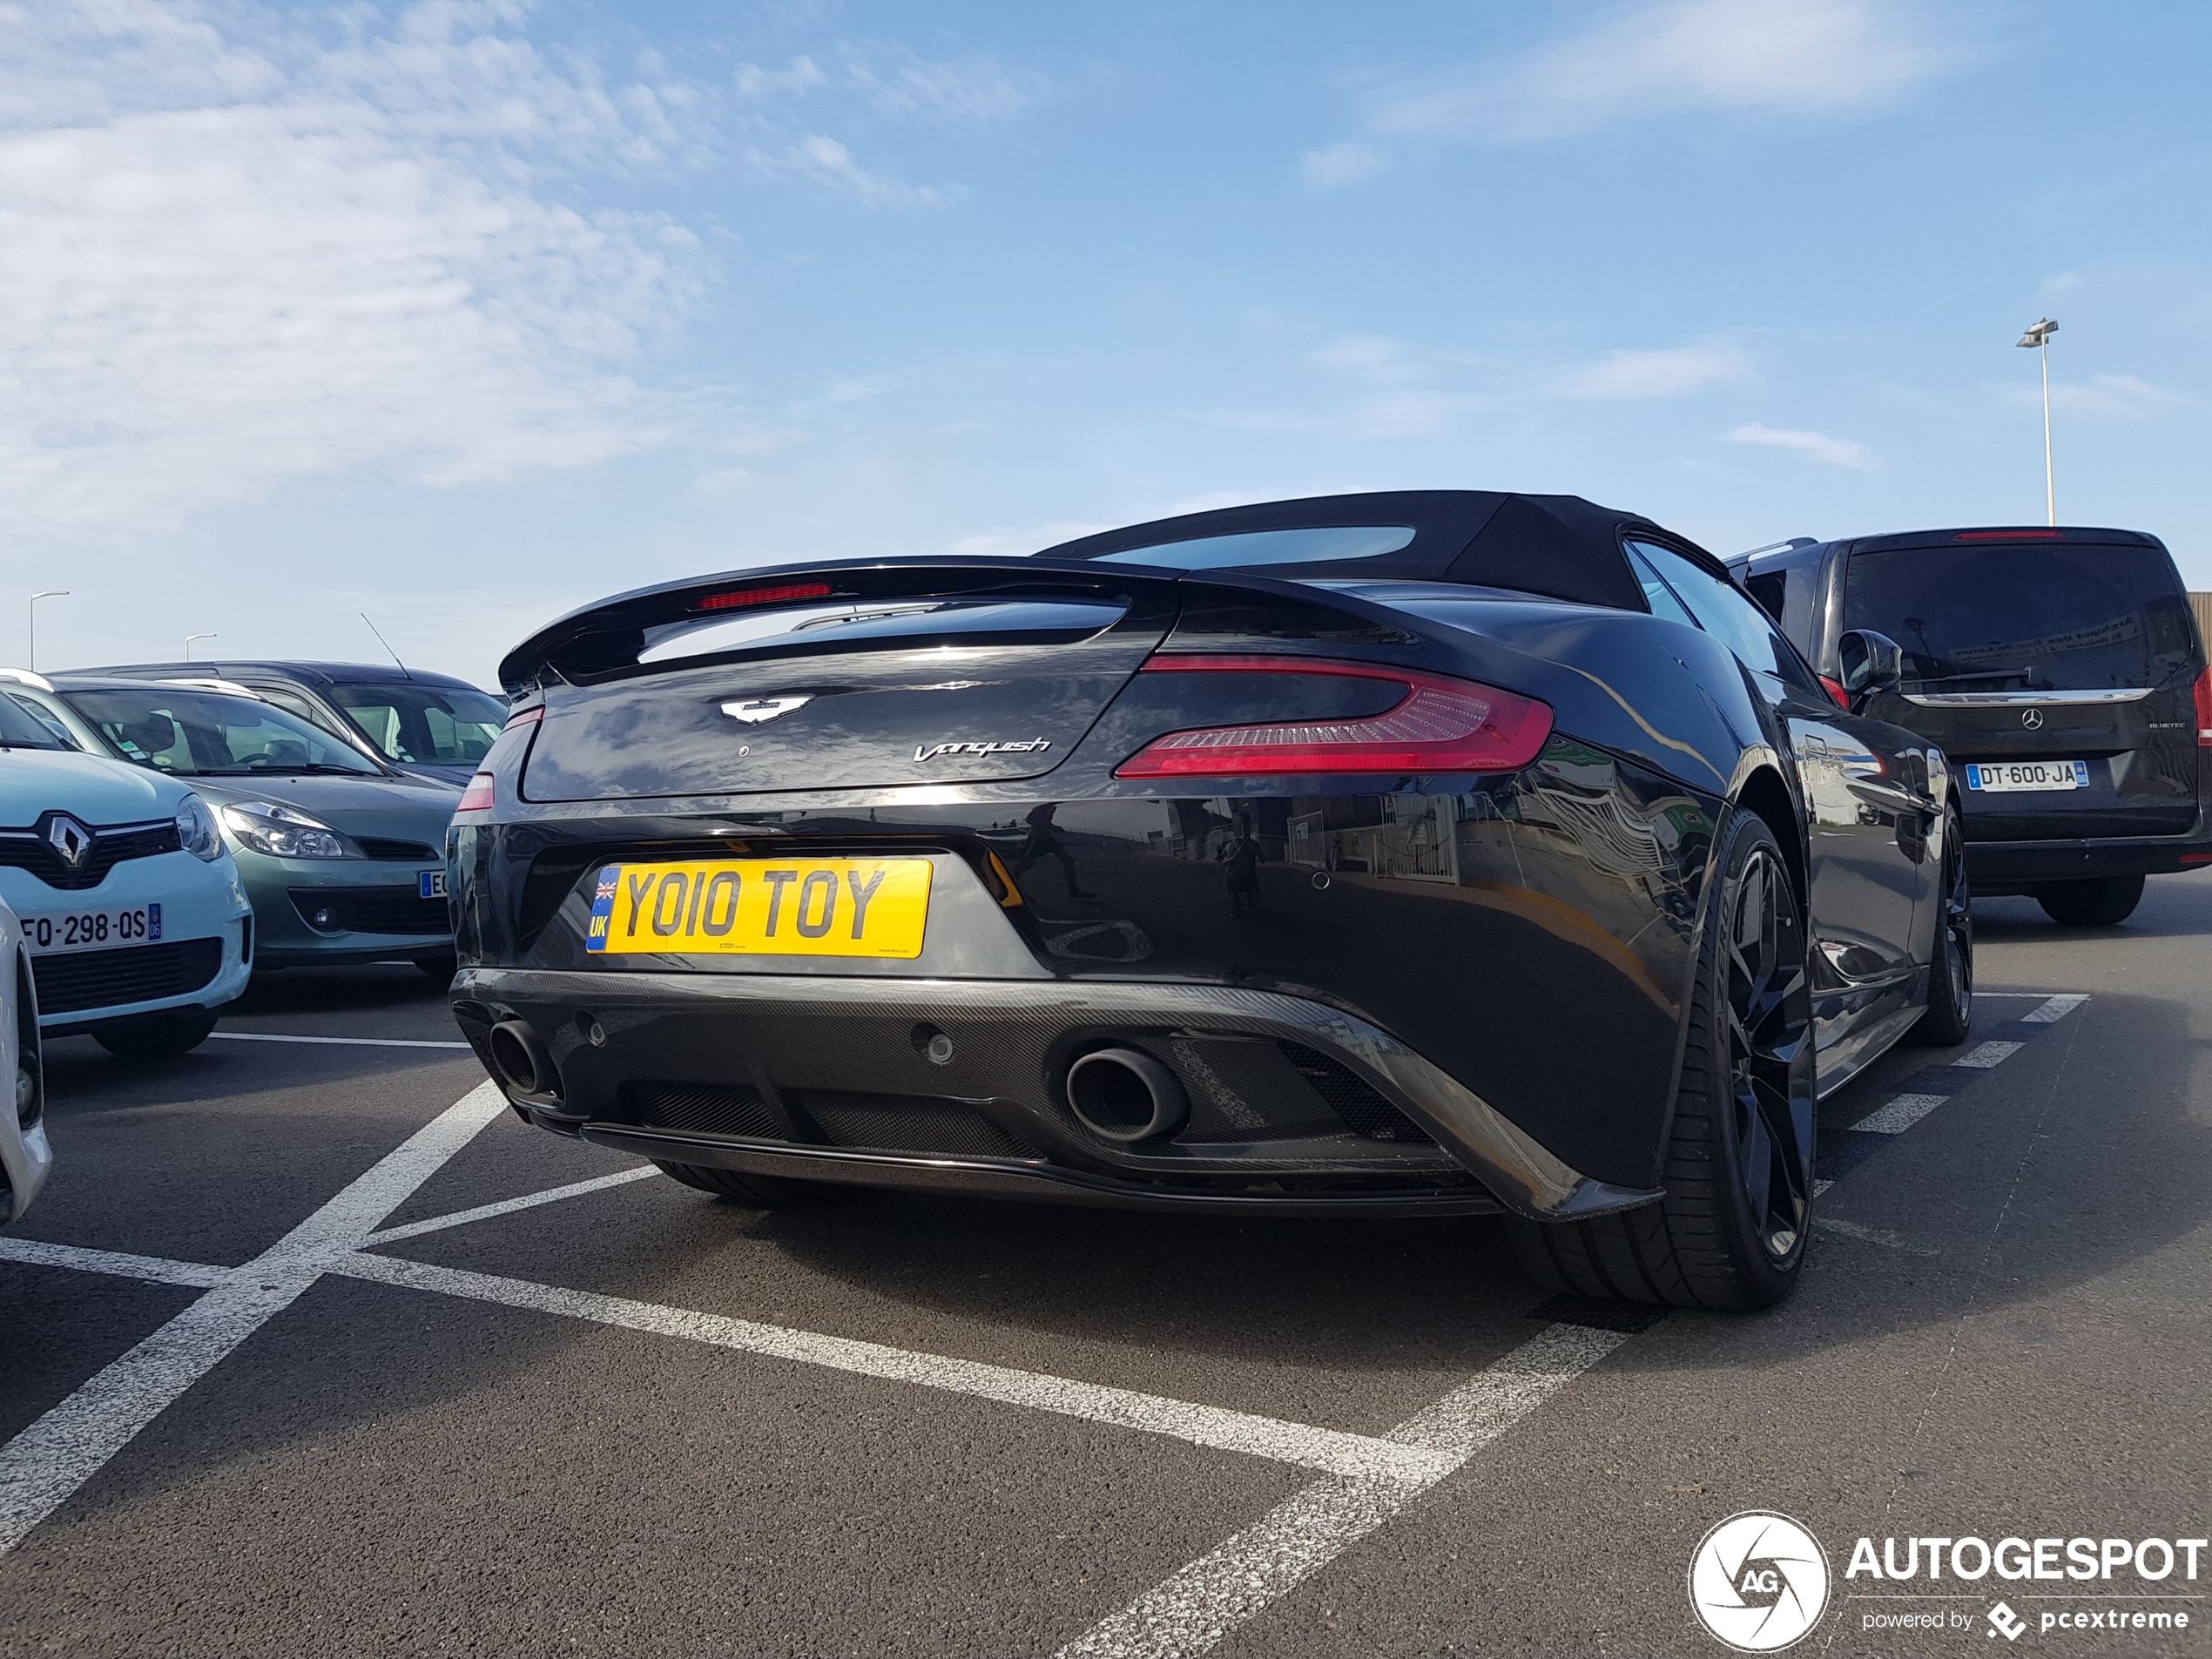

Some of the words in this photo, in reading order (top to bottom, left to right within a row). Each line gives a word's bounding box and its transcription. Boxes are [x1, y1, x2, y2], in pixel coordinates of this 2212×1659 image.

[914, 737, 1051, 762] Vanquish
[1980, 765, 2075, 785] DT-600-JA
[2077, 774, 2087, 784] 06
[763, 870, 886, 940] TOY
[150, 923, 160, 936] 06
[590, 915, 609, 938] UK
